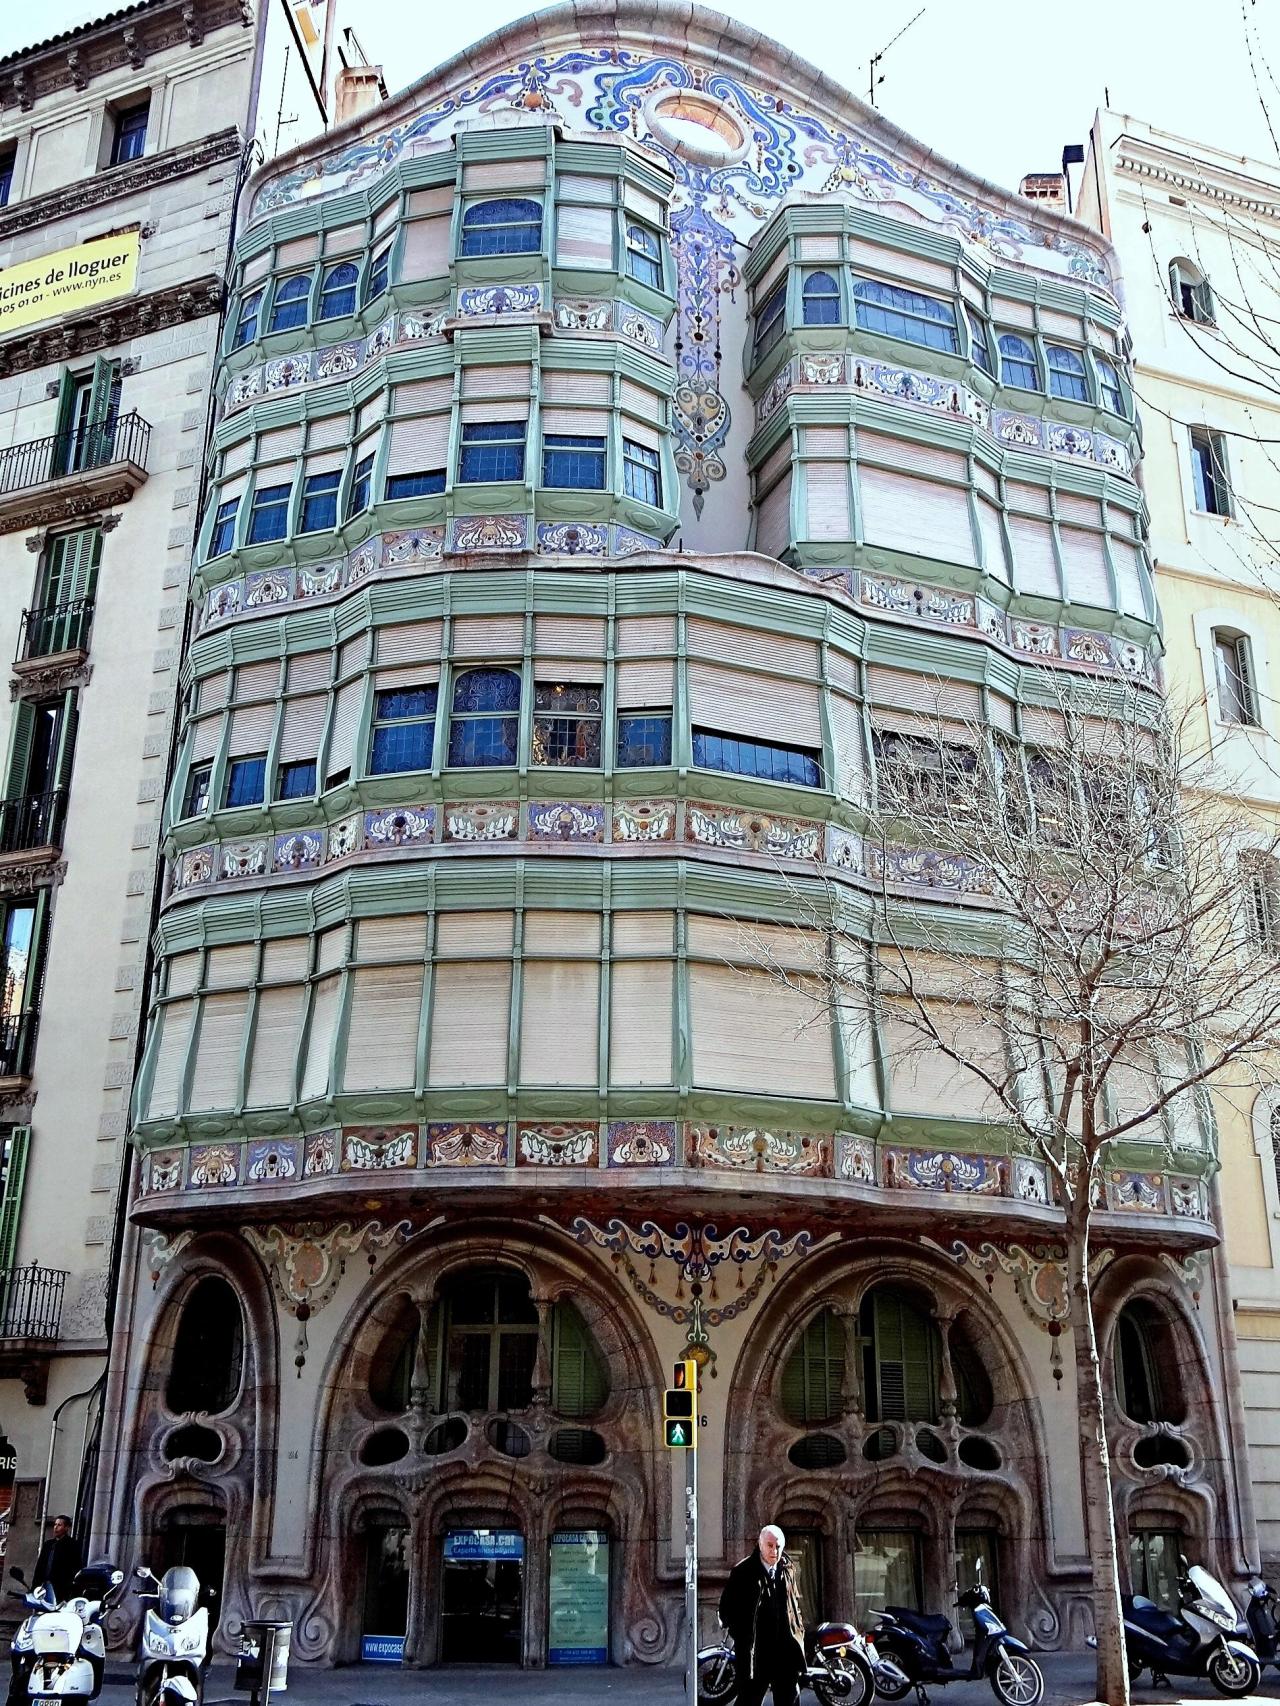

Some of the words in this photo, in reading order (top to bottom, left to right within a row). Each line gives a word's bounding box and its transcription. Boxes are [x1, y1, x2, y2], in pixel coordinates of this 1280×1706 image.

[45, 268, 64, 286] de
[68, 253, 130, 278] lloguer
[18, 299, 29, 308] 01
[32, 294, 43, 304] 01
[52, 272, 122, 297] www.nyn.es
